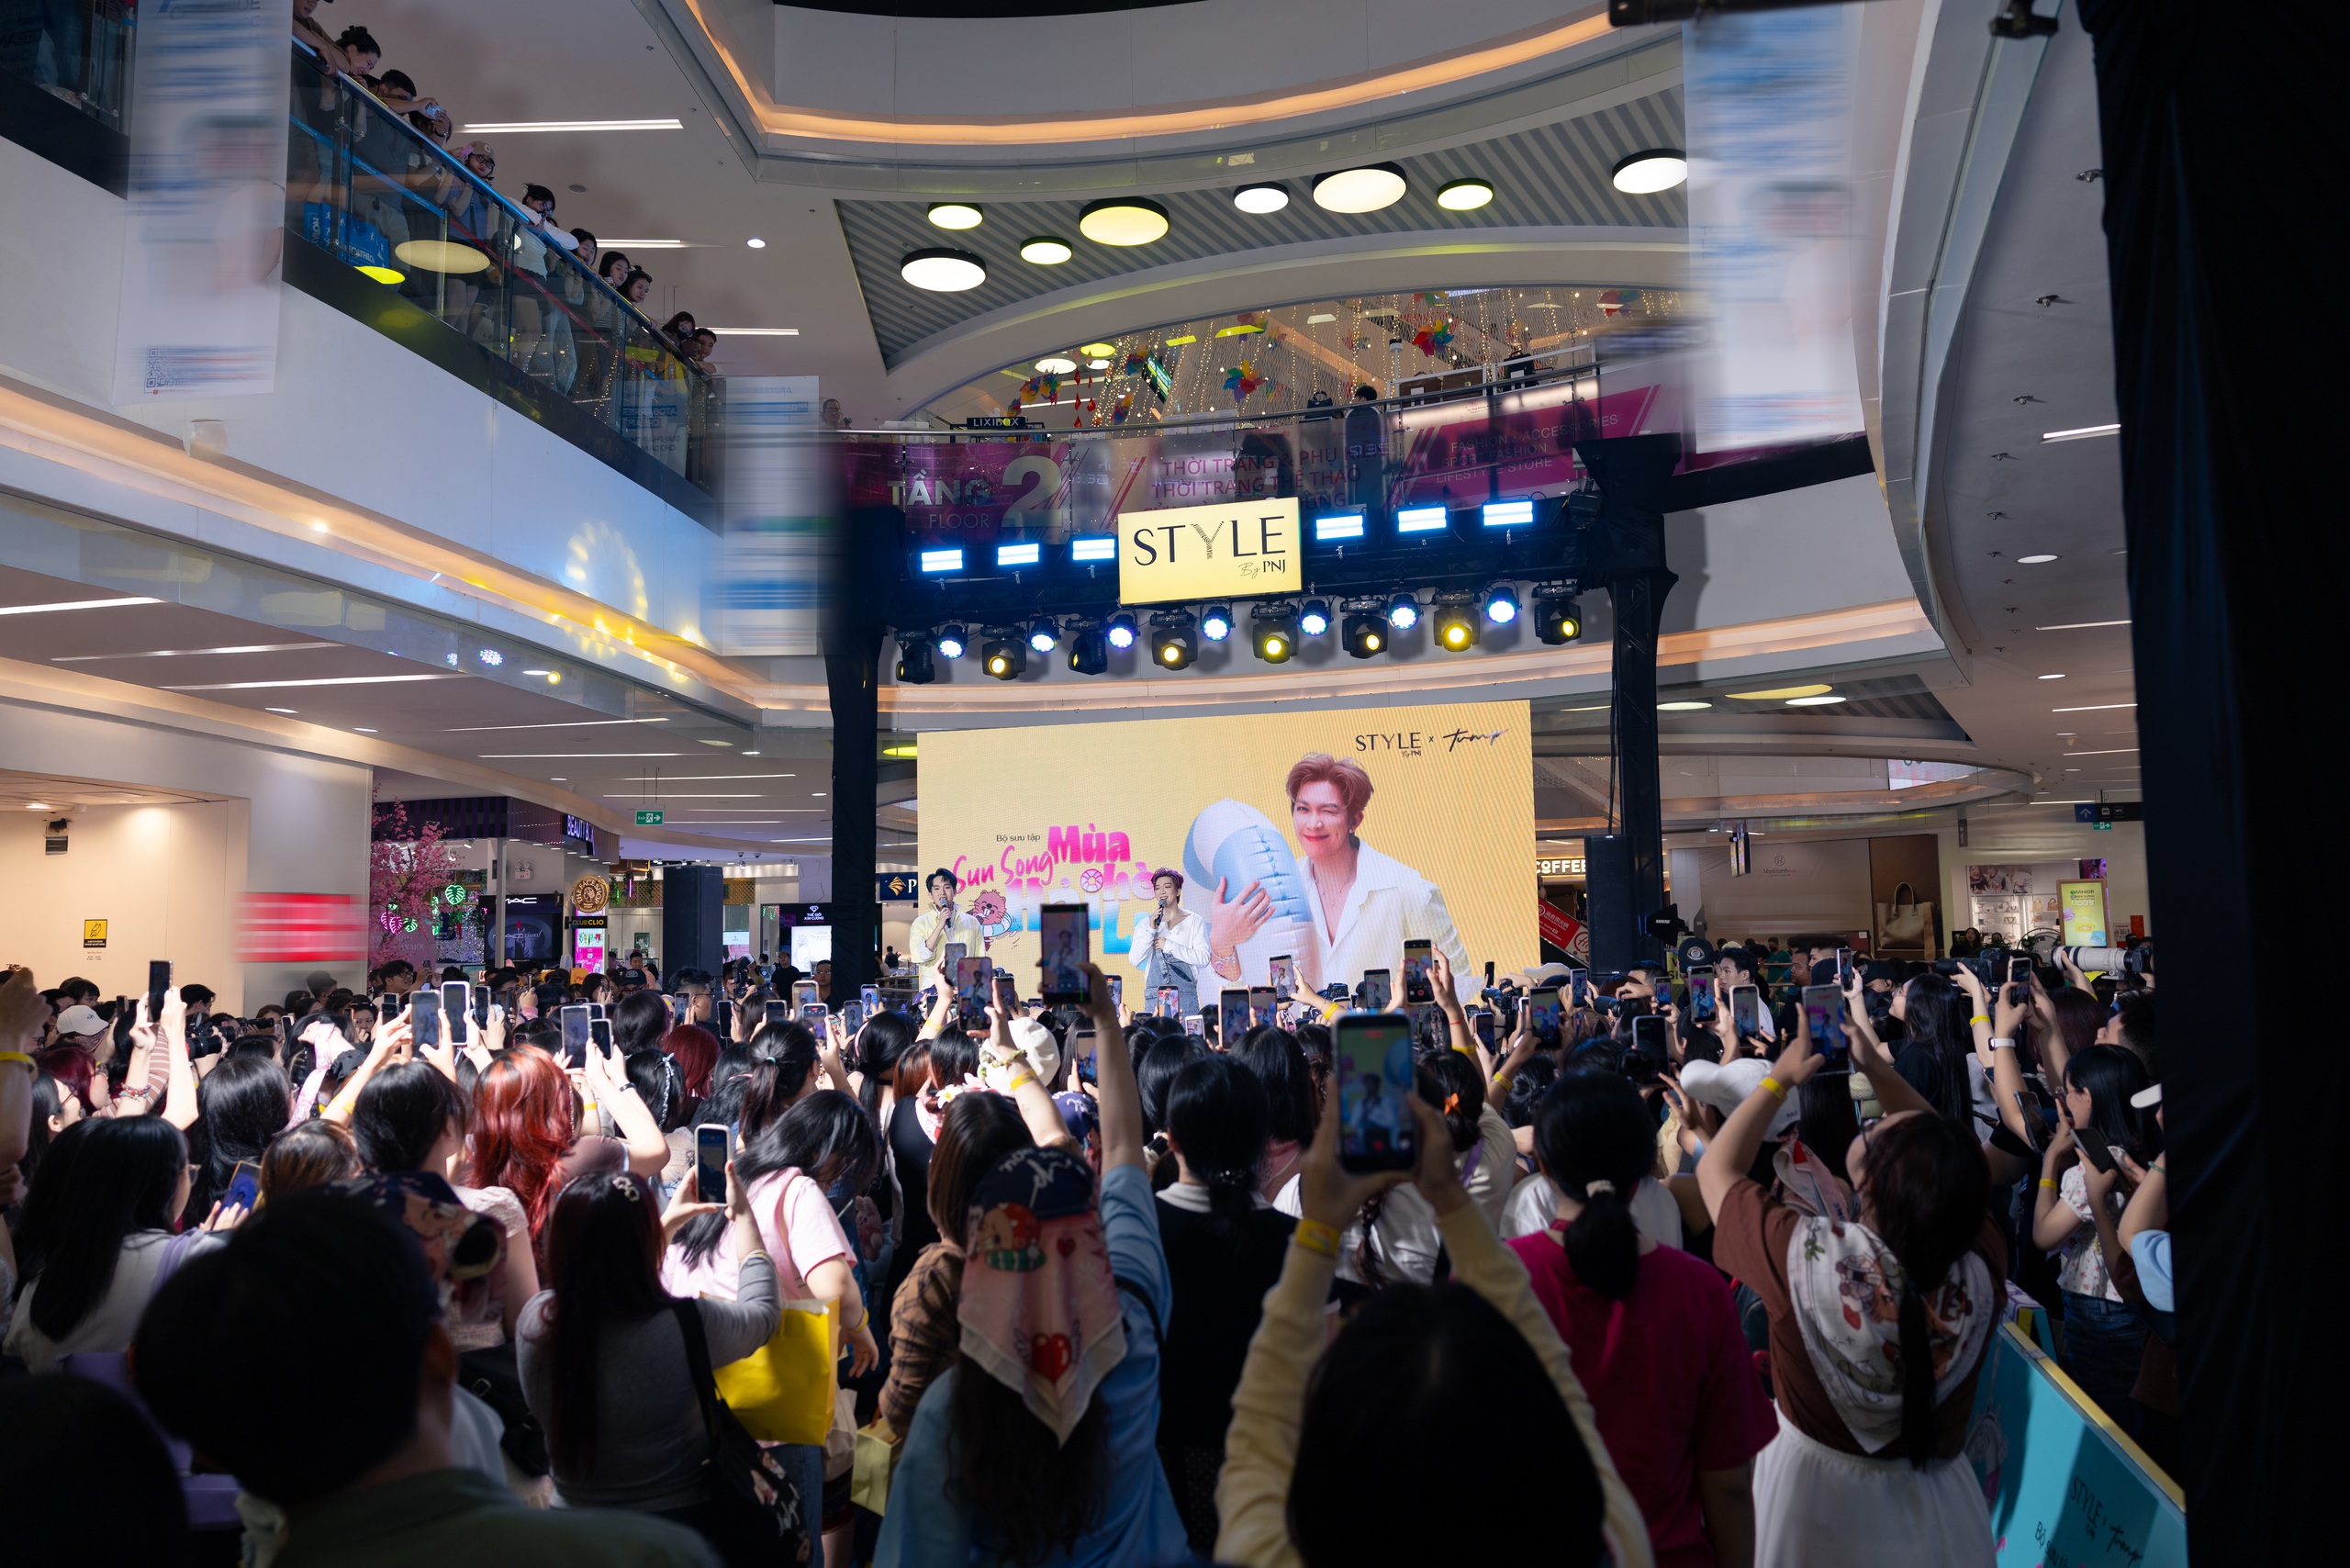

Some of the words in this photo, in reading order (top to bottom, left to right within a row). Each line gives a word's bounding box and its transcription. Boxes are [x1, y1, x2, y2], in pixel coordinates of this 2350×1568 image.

[1450, 434, 1508, 453] FASHION
[1523, 413, 1618, 439] ACCESSORIES
[1162, 457, 1206, 476] THỜI
[1212, 455, 1275, 475] TRANG
[1300, 447, 1337, 466] PHỤ
[1441, 453, 1484, 468] SPORT
[1489, 442, 1548, 460] FASHION
[1507, 459, 1553, 473] STORE
[887, 468, 991, 506] TẦNG
[1001, 454, 1063, 528] 2
[1152, 479, 1200, 498] THỜI
[1202, 476, 1265, 498] TRANG
[1309, 466, 1361, 487] THAO
[929, 513, 990, 529] FLOOR
[1133, 515, 1286, 566] STYLE
[1238, 562, 1260, 578] By
[1263, 559, 1286, 575] PNJ
[1355, 732, 1422, 752] STYLE
[996, 834, 1008, 843] Bộ
[1027, 834, 1041, 843] tập
[1047, 823, 1132, 865] Mùa
[953, 855, 994, 894] Sun
[1001, 845, 1054, 886] Song
[1537, 859, 1586, 873] COFFEE
[2070, 1476, 2102, 1529] STYLE
